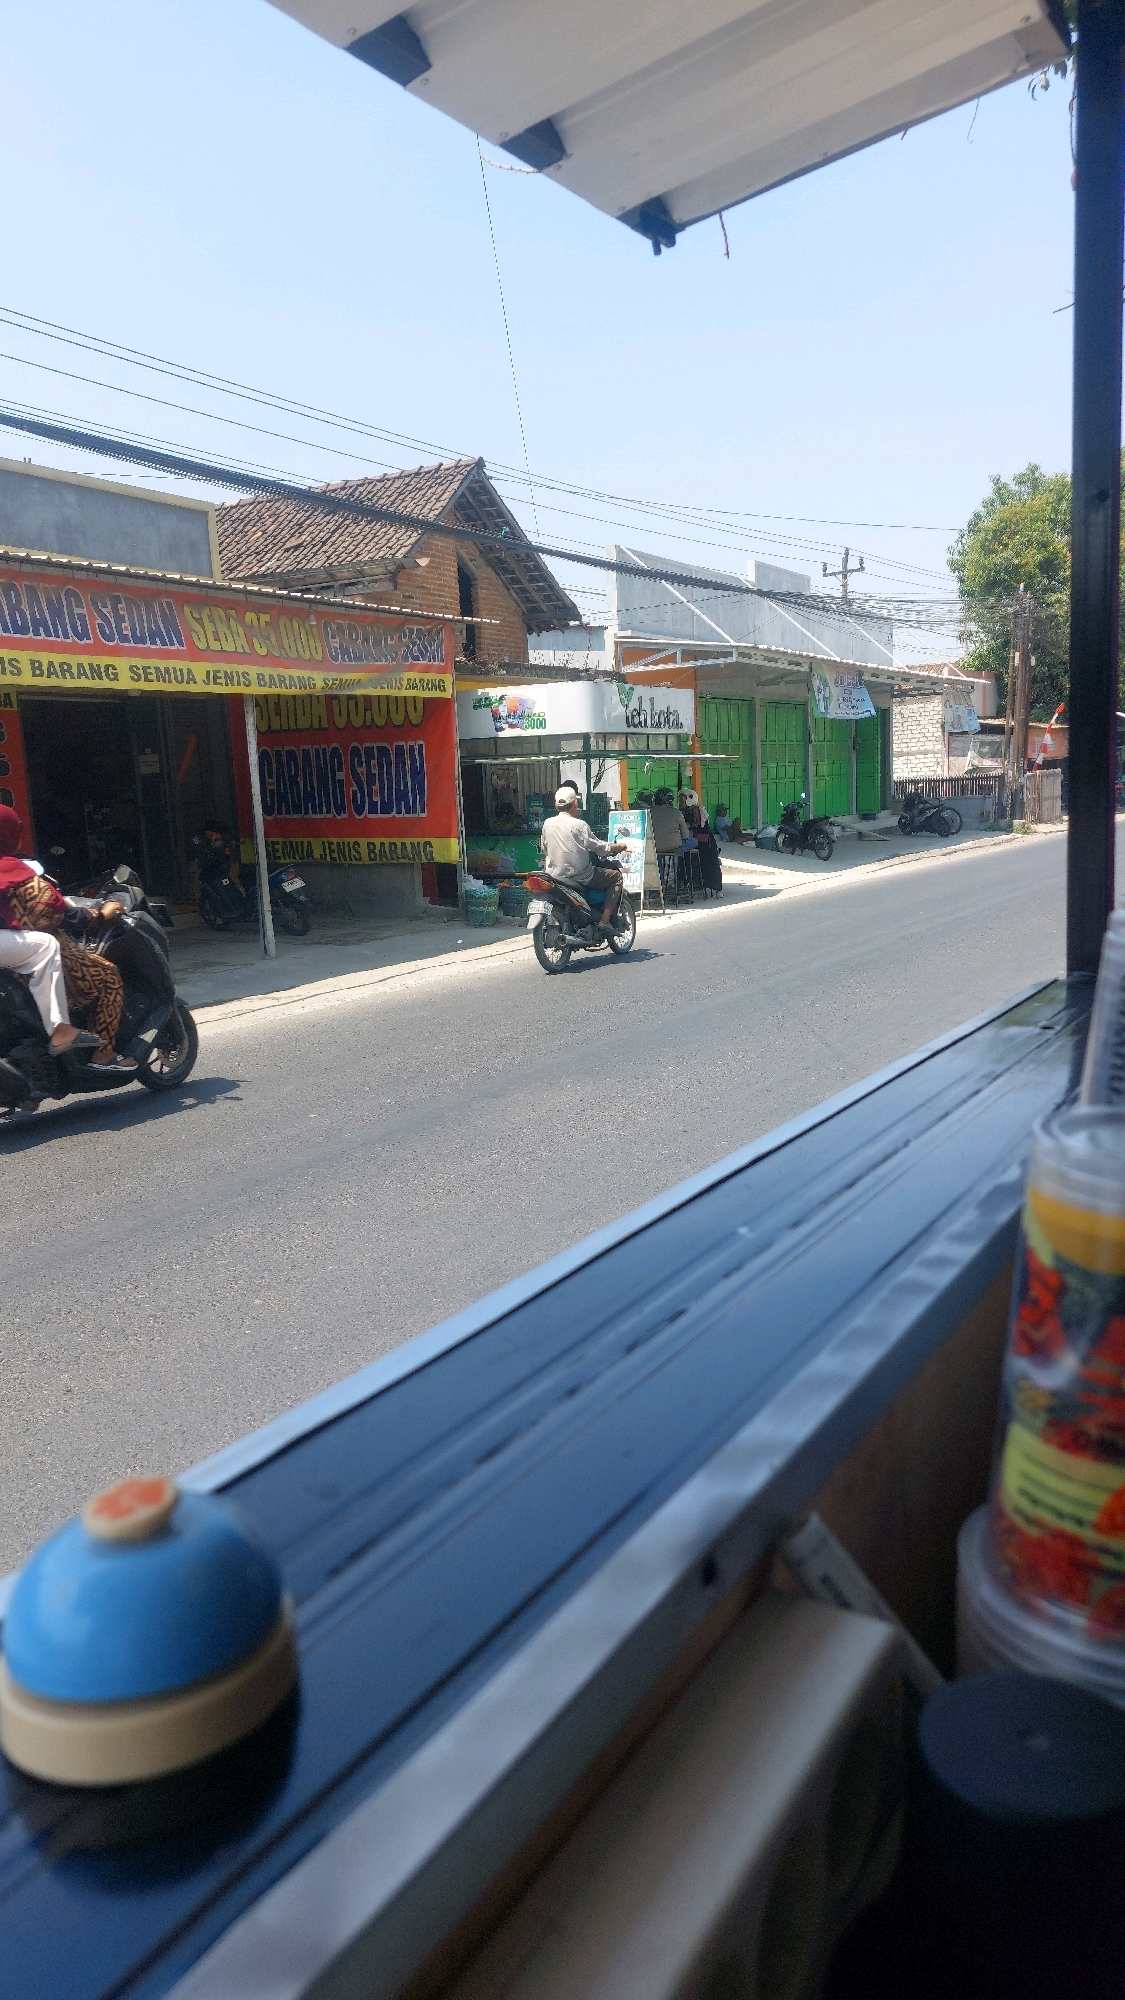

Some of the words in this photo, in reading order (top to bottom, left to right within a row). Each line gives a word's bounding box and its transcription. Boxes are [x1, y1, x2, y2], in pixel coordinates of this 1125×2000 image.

[0, 581, 93, 644] BANG
[89, 588, 186, 649] SEDAN
[322, 619, 399, 665] CABANG
[29, 658, 119, 681] BARANG
[129, 664, 197, 685] SEMUA
[202, 669, 252, 687] JENIS
[256, 672, 317, 690] BARANG
[405, 677, 446, 692] BARANG
[524, 718, 547, 730] 3000
[625, 696, 648, 729] teh
[258, 743, 348, 819] CABANG
[348, 740, 428, 819] SEDAN
[264, 840, 314, 860] SEMUA
[320, 841, 362, 862] JENIS
[366, 841, 435, 862] BARANG
